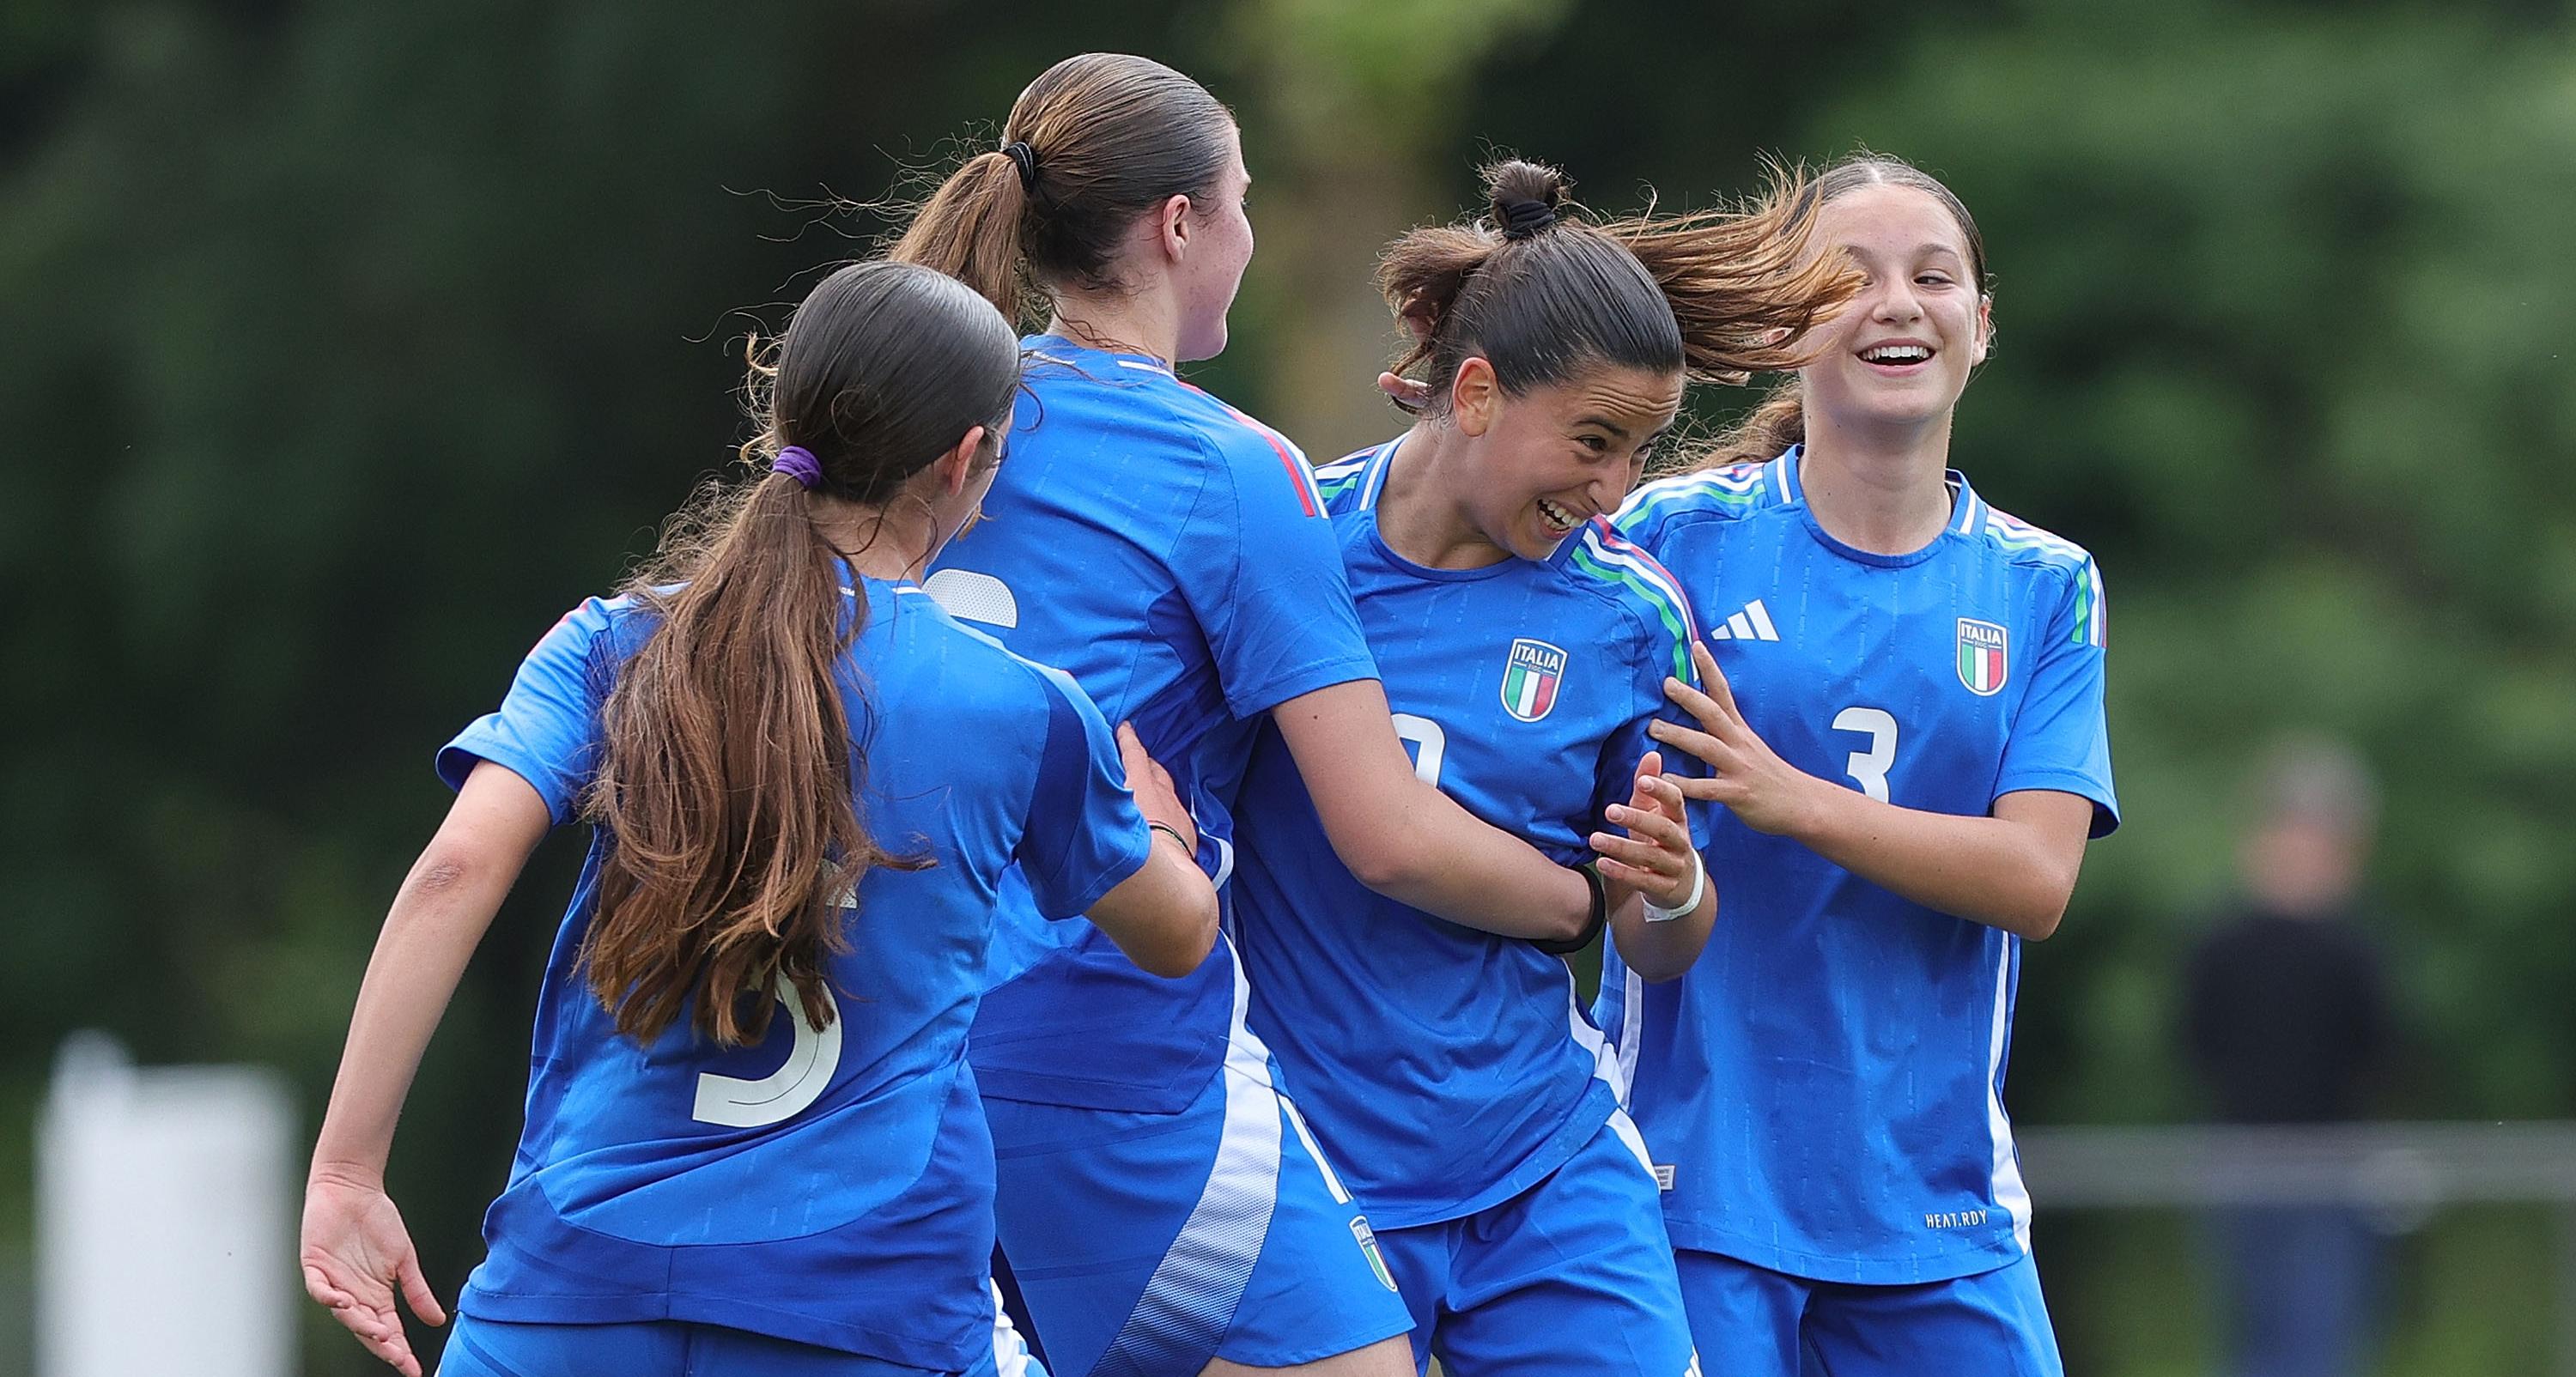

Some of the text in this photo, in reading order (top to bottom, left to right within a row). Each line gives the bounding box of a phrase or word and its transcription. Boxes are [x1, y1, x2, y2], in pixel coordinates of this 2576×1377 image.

[1961, 622, 2002, 645] ITALIA
[1514, 644, 1558, 670] ITALIA
[1832, 707, 1899, 804] 3
[1925, 1209, 1988, 1228] HEAT.RDY
